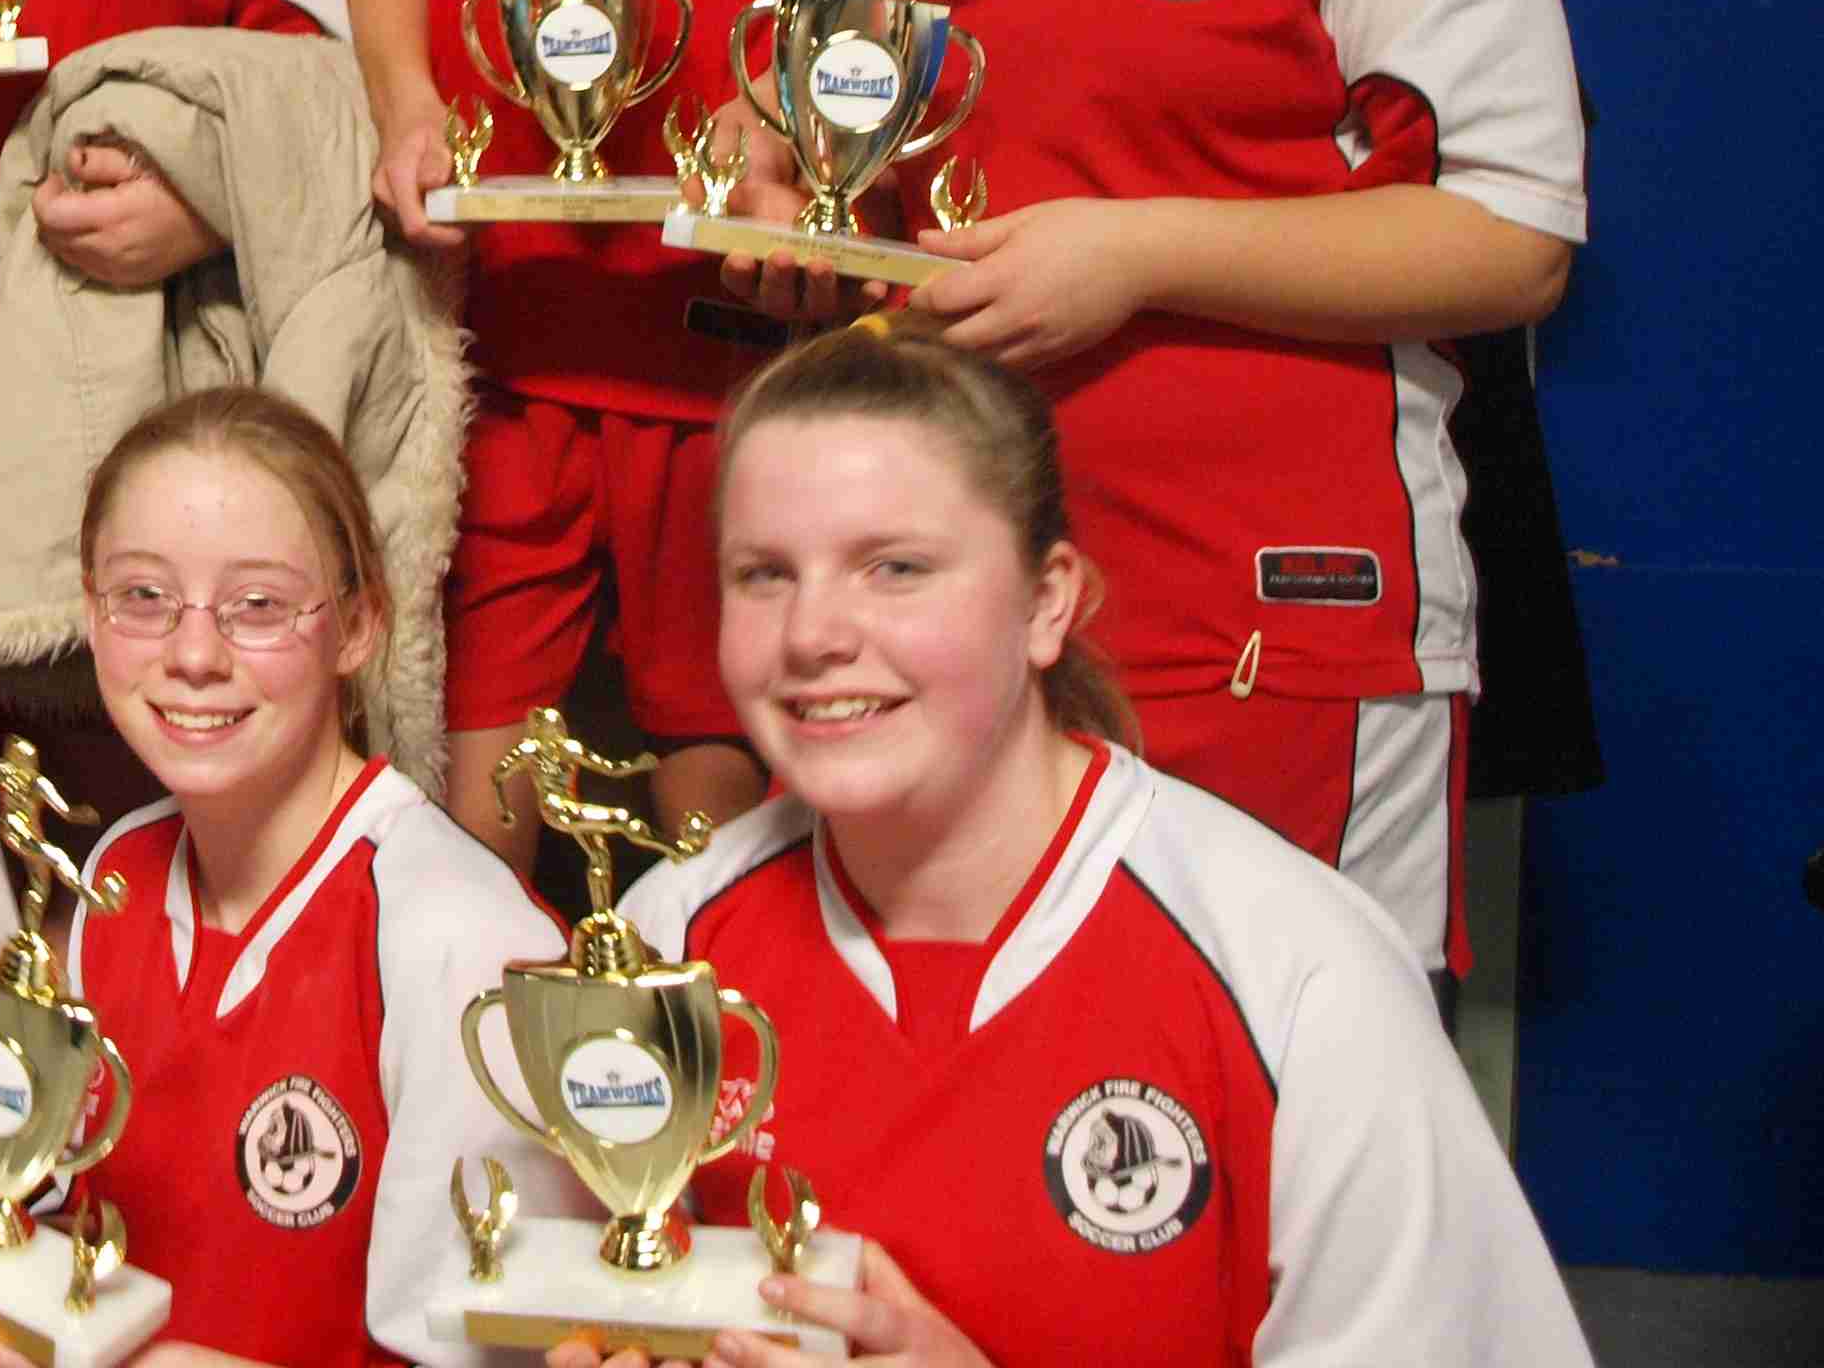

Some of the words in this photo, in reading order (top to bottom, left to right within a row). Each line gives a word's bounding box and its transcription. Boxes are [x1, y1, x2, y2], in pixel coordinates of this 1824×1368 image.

[816, 69, 894, 100] TEAMWORKS
[567, 1076, 666, 1108] TEAMWORKS
[1104, 1078, 1143, 1096] FIRE
[1138, 1217, 1185, 1252] CLUB
